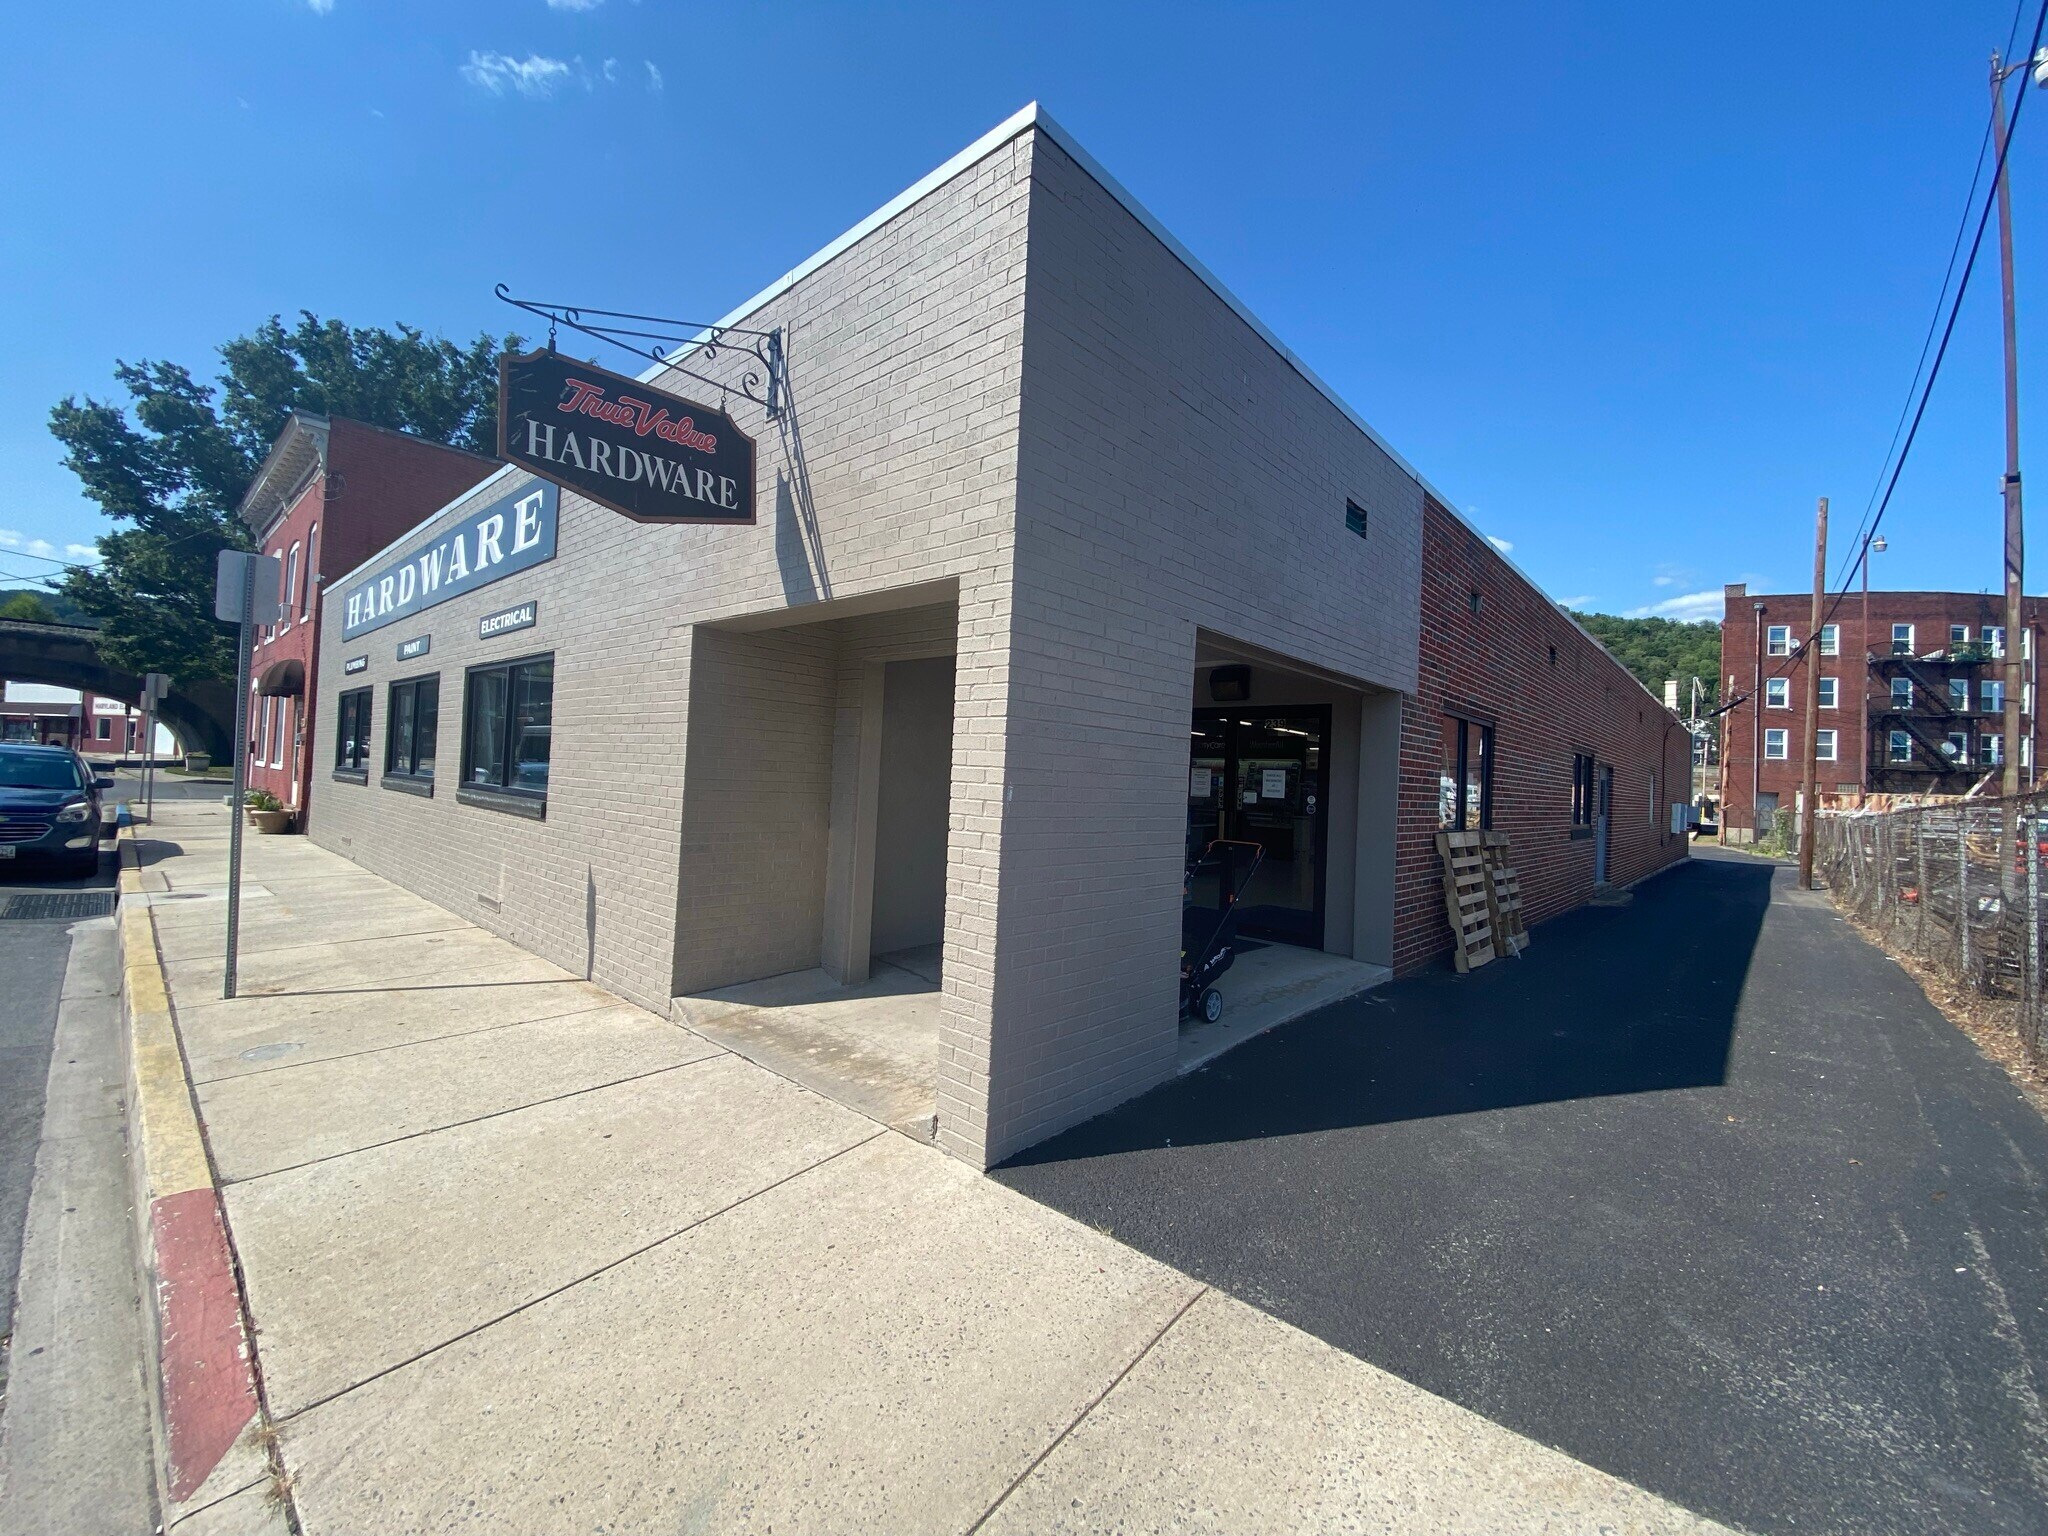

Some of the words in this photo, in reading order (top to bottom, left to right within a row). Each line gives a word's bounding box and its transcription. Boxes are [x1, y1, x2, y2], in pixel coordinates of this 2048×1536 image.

[557, 377, 635, 427] True
[617, 395, 717, 453] Value
[525, 419, 739, 510] HARDWARE
[346, 489, 544, 630] HARDWARE
[481, 606, 532, 634] ELECTRICAL
[404, 640, 421, 655] PAINT
[1265, 718, 1285, 729] 239
